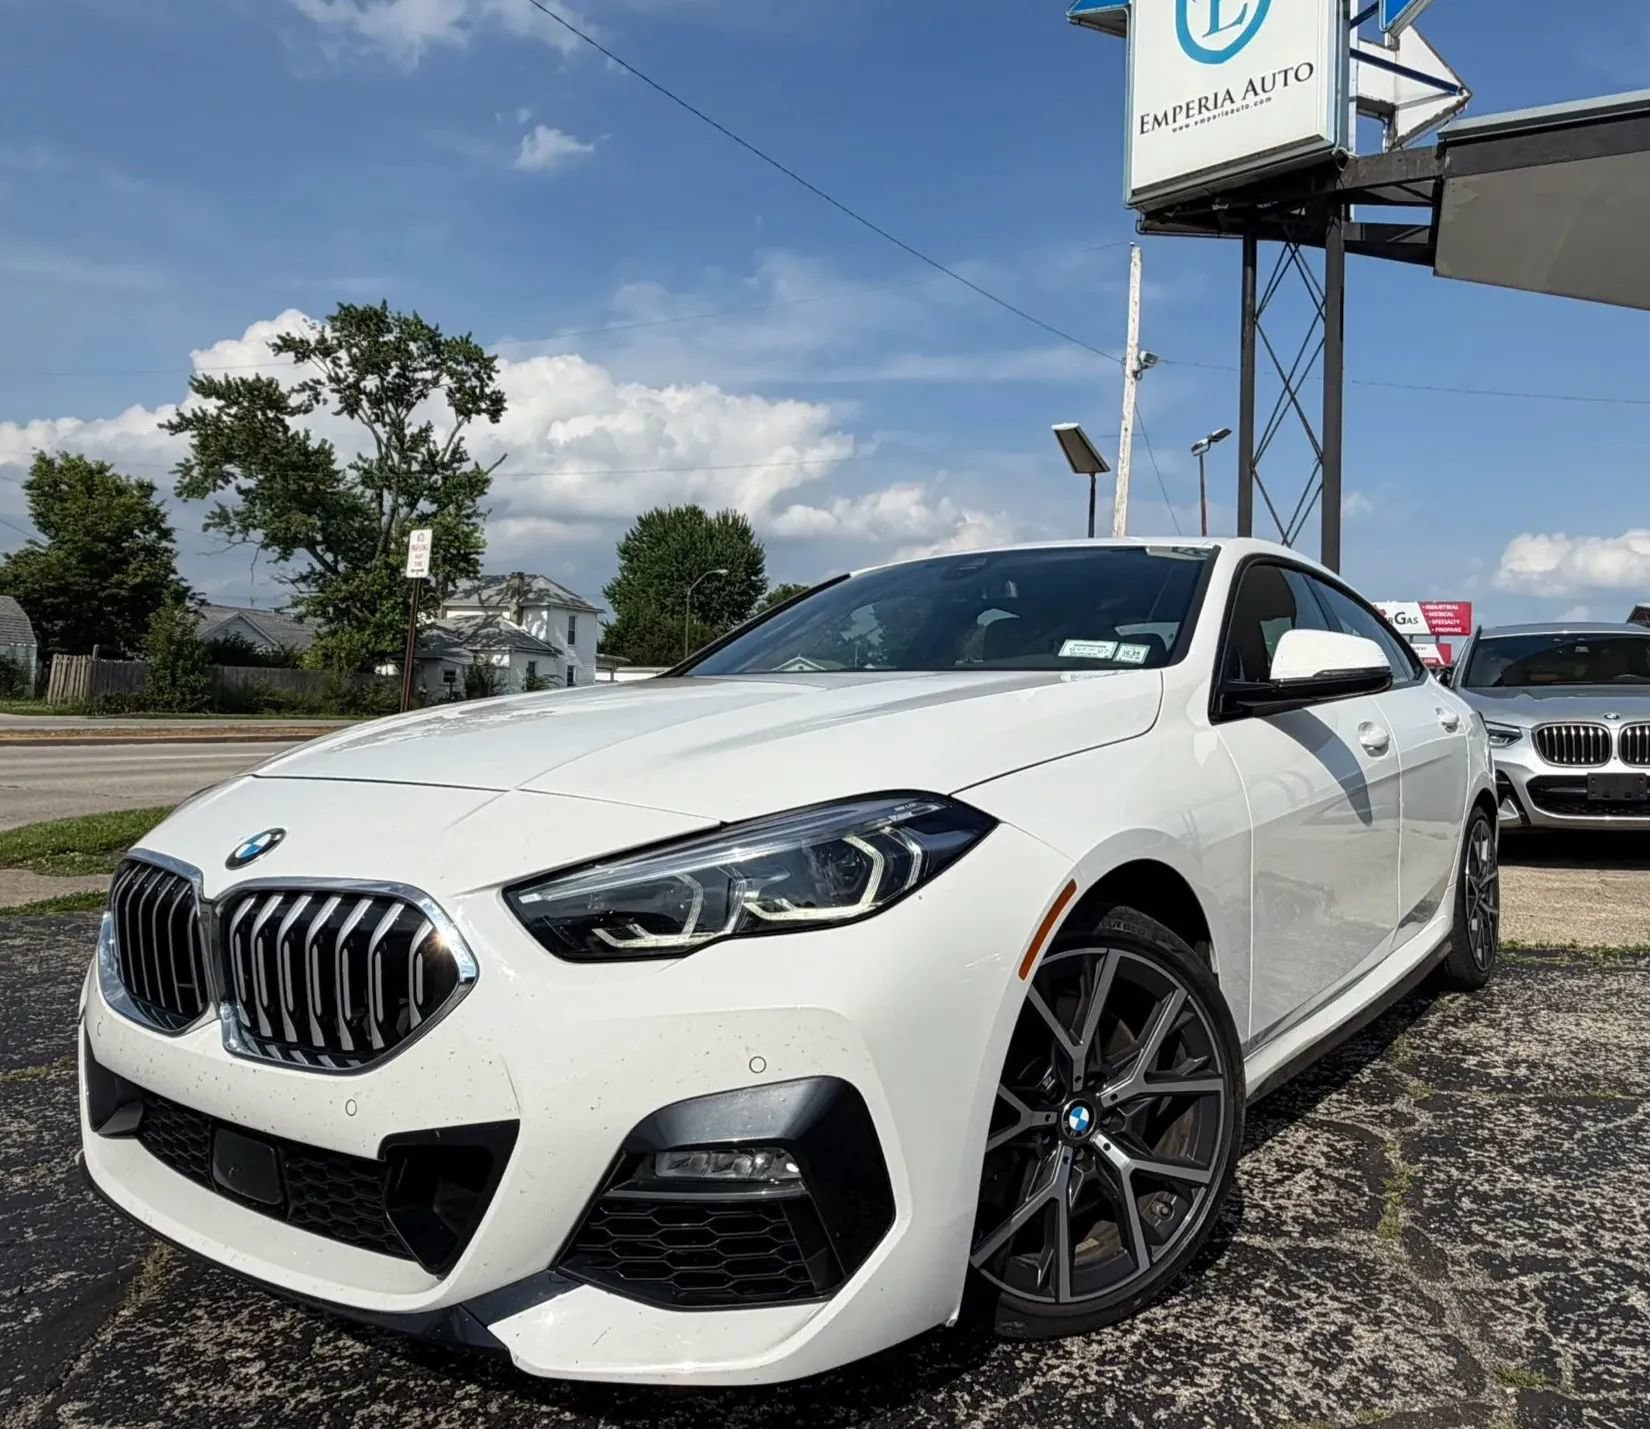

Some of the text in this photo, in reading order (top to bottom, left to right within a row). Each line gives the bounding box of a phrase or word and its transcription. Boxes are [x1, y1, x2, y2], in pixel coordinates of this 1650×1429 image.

[1139, 62, 1314, 135] EMPERIA AUTO
[1172, 96, 1272, 133] www.emperiaauto.com
